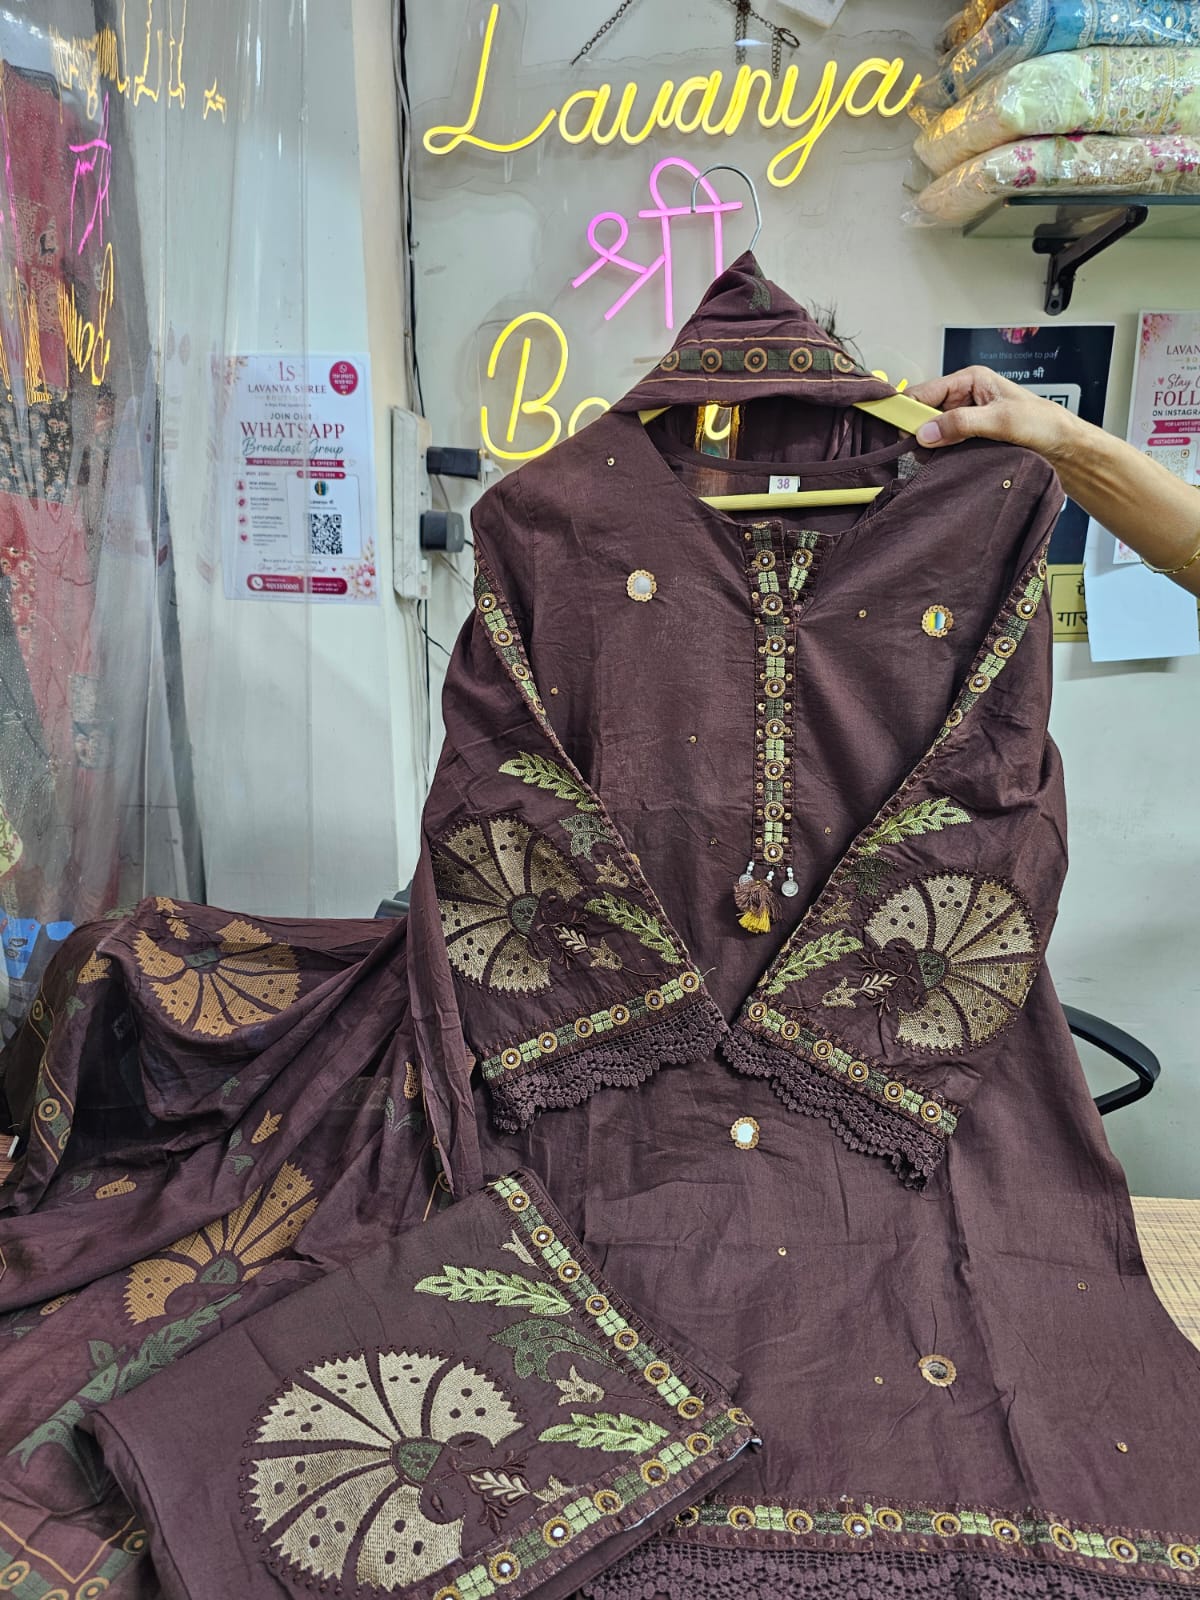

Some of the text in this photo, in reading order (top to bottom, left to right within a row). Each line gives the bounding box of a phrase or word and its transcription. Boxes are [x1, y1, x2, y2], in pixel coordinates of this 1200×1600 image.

[422, 3, 922, 188] Lavanya
[571, 156, 744, 329] श्री
[980, 352, 998, 360] Scan
[1000, 352, 1013, 360] this
[1014, 352, 1033, 360] code
[1044, 352, 1058, 361] pay
[1032, 365, 1045, 379] श्री
[248, 383, 327, 394] LAVANYA SREE
[1166, 373, 1191, 392] Stay
[1153, 390, 1200, 407] FOLL
[270, 412, 290, 420] JOIN
[240, 421, 345, 439] WHATSAPP
[242, 437, 301, 456] Broadcast
[777, 478, 790, 490] 38
